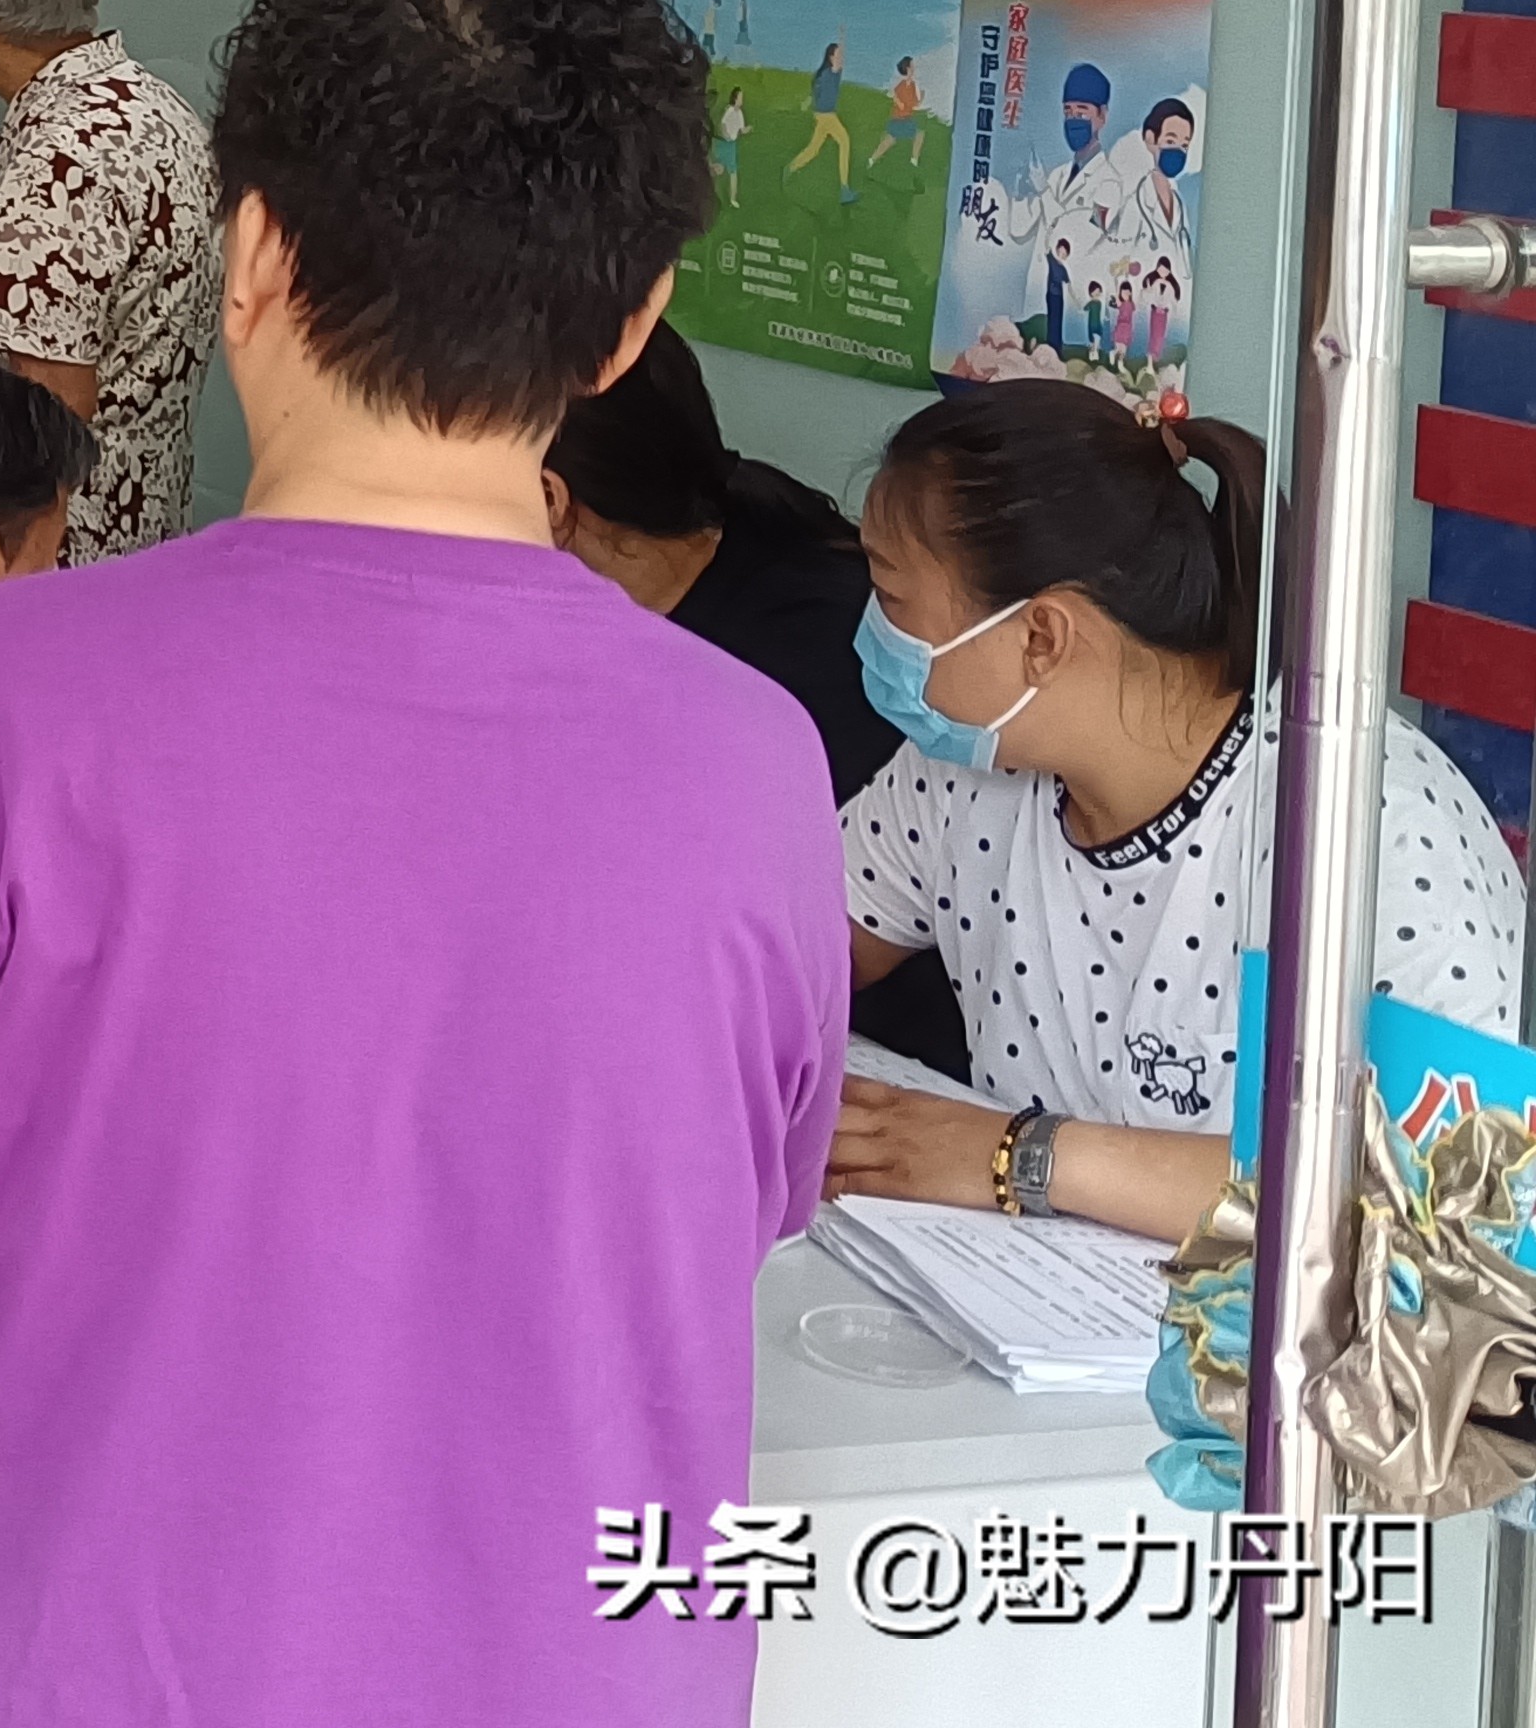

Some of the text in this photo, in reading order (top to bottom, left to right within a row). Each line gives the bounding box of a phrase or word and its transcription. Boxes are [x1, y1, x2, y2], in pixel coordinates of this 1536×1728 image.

[1001, 3, 1030, 129] 家庭医生
[1095, 836, 1147, 867] Feel
[1146, 802, 1186, 845] For
